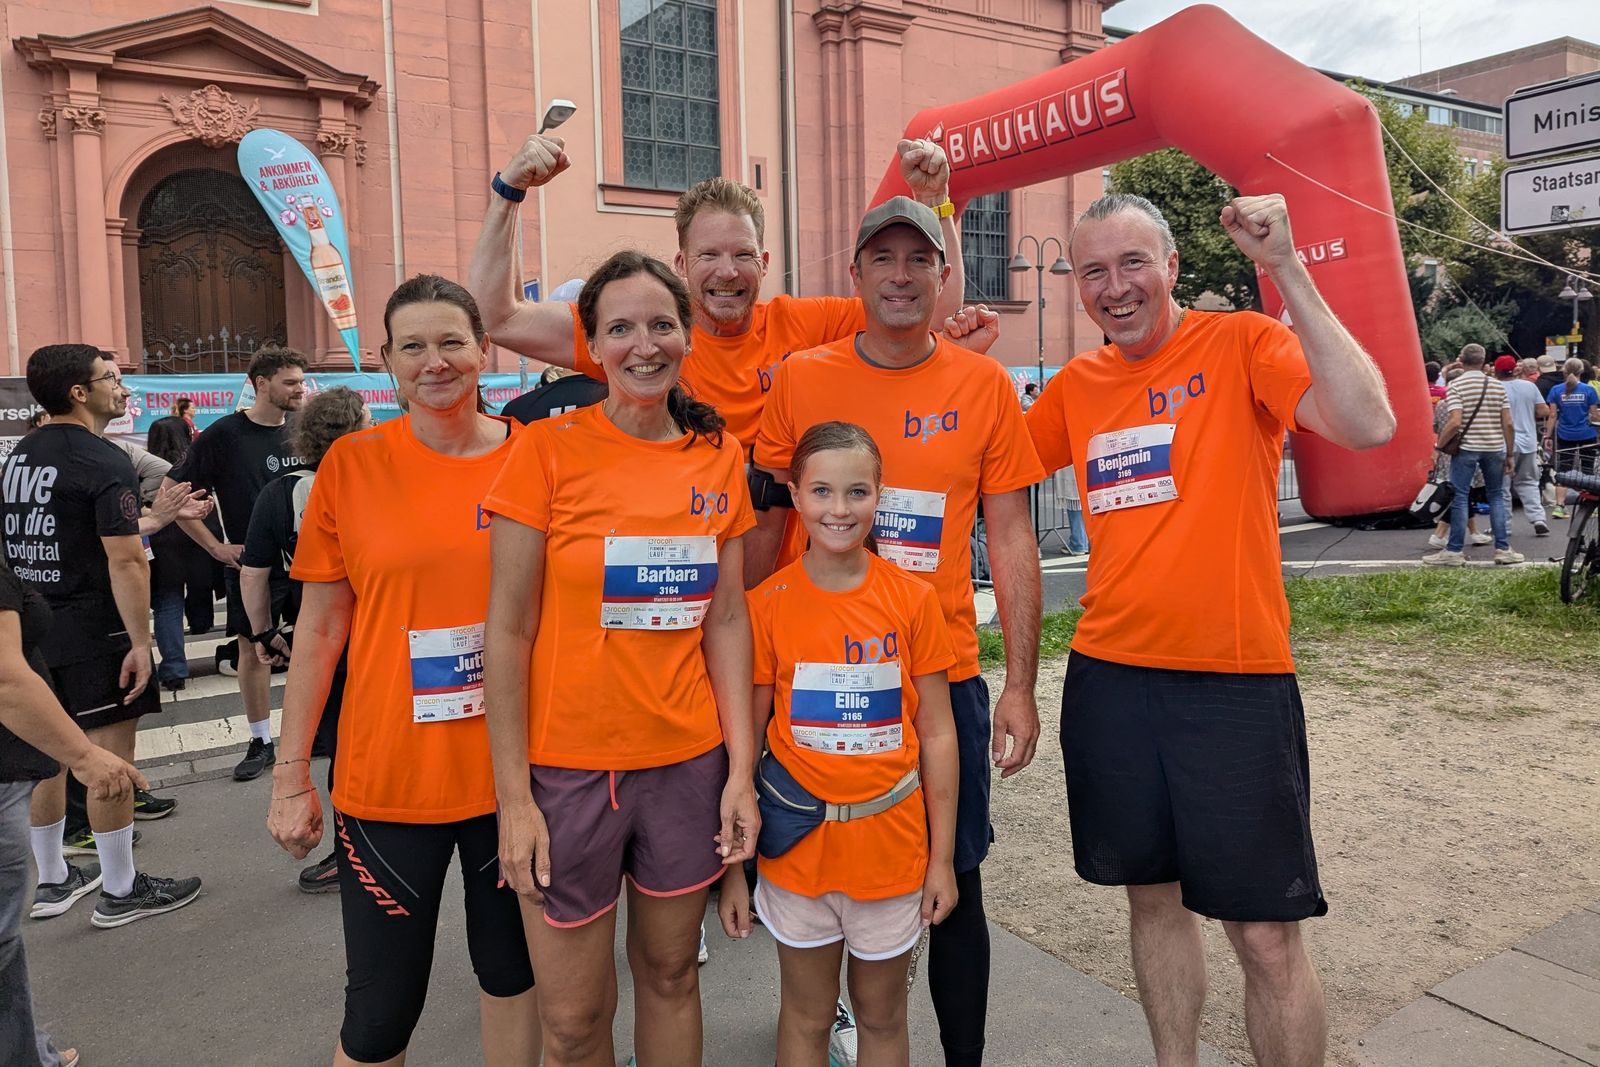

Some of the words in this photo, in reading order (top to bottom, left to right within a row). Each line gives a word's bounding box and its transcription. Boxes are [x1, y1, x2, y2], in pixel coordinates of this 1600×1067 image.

[949, 78, 1125, 164] BAUHAUS
[1533, 103, 1600, 134] Minis
[259, 161, 312, 178] ANKOMMEN
[260, 180, 269, 192] &
[272, 173, 319, 191] ABKÜHLEN
[1147, 372, 1206, 419] bpa
[904, 410, 959, 443] bpa
[1097, 450, 1151, 473] Benjamin
[3, 454, 58, 504] live
[1117, 469, 1132, 479] 3169
[690, 486, 728, 522] bpa
[25, 507, 56, 536] die
[875, 512, 917, 532] hilipp
[880, 530, 899, 538] 3166
[637, 566, 698, 583] Barbara
[659, 586, 679, 595] 3164
[452, 640, 467, 649] LAUF
[844, 631, 898, 664] bpa
[835, 692, 870, 709] Ellie
[842, 712, 862, 721] 3165
